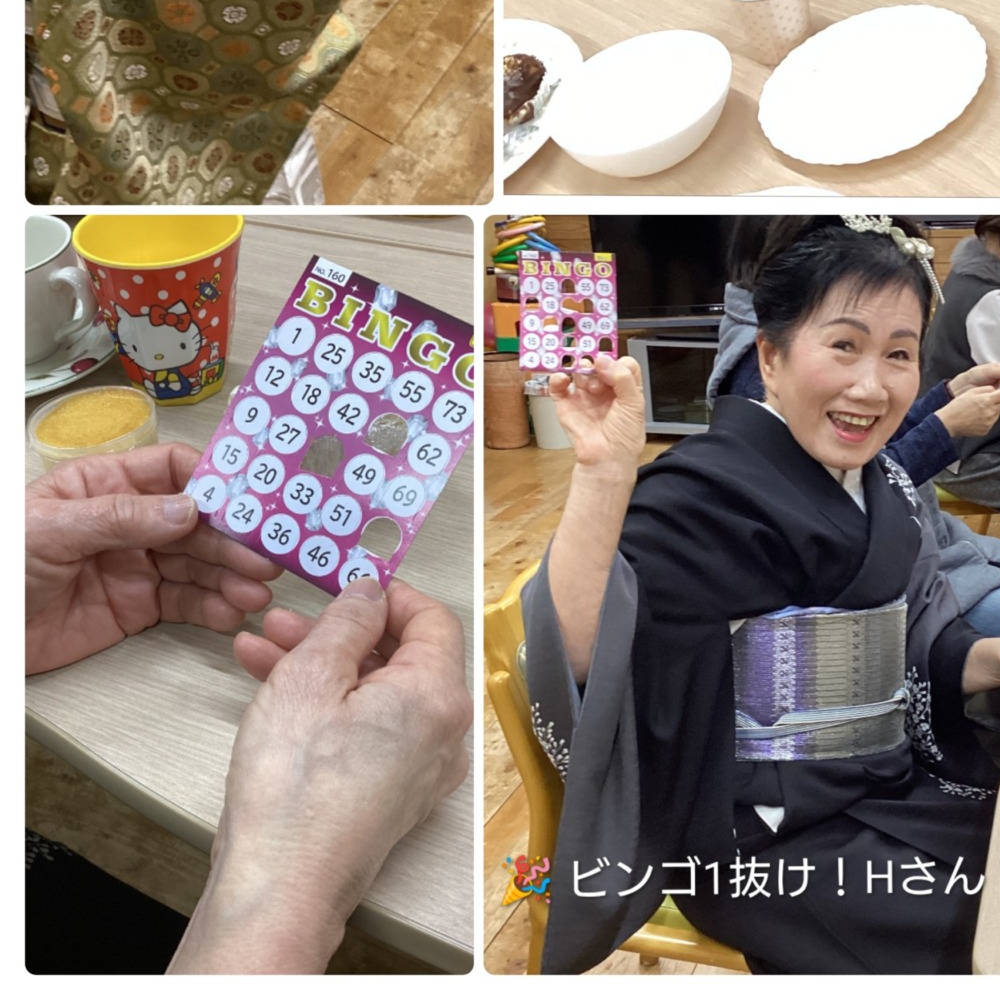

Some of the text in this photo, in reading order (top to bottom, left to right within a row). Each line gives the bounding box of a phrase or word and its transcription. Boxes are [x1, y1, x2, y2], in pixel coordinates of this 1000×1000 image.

[327, 268, 346, 284] 160
[522, 260, 613, 278] BINGO
[529, 281, 609, 292] 1 25 55 73
[546, 300, 610, 311] 18 62
[529, 318, 611, 330] 9 49 69
[527, 337, 592, 348] 15 20 51
[528, 355, 555, 365] 4 24
[291, 327, 467, 424] 1 25 35 55 73
[264, 365, 443, 467] 12 18 42 62
[245, 407, 417, 508] 9 27 49 69
[221, 444, 353, 527] 15 20 33 51
[203, 486, 216, 503] 4
[231, 502, 255, 525] 24
[267, 522, 292, 546] 36
[307, 545, 331, 568] 46
